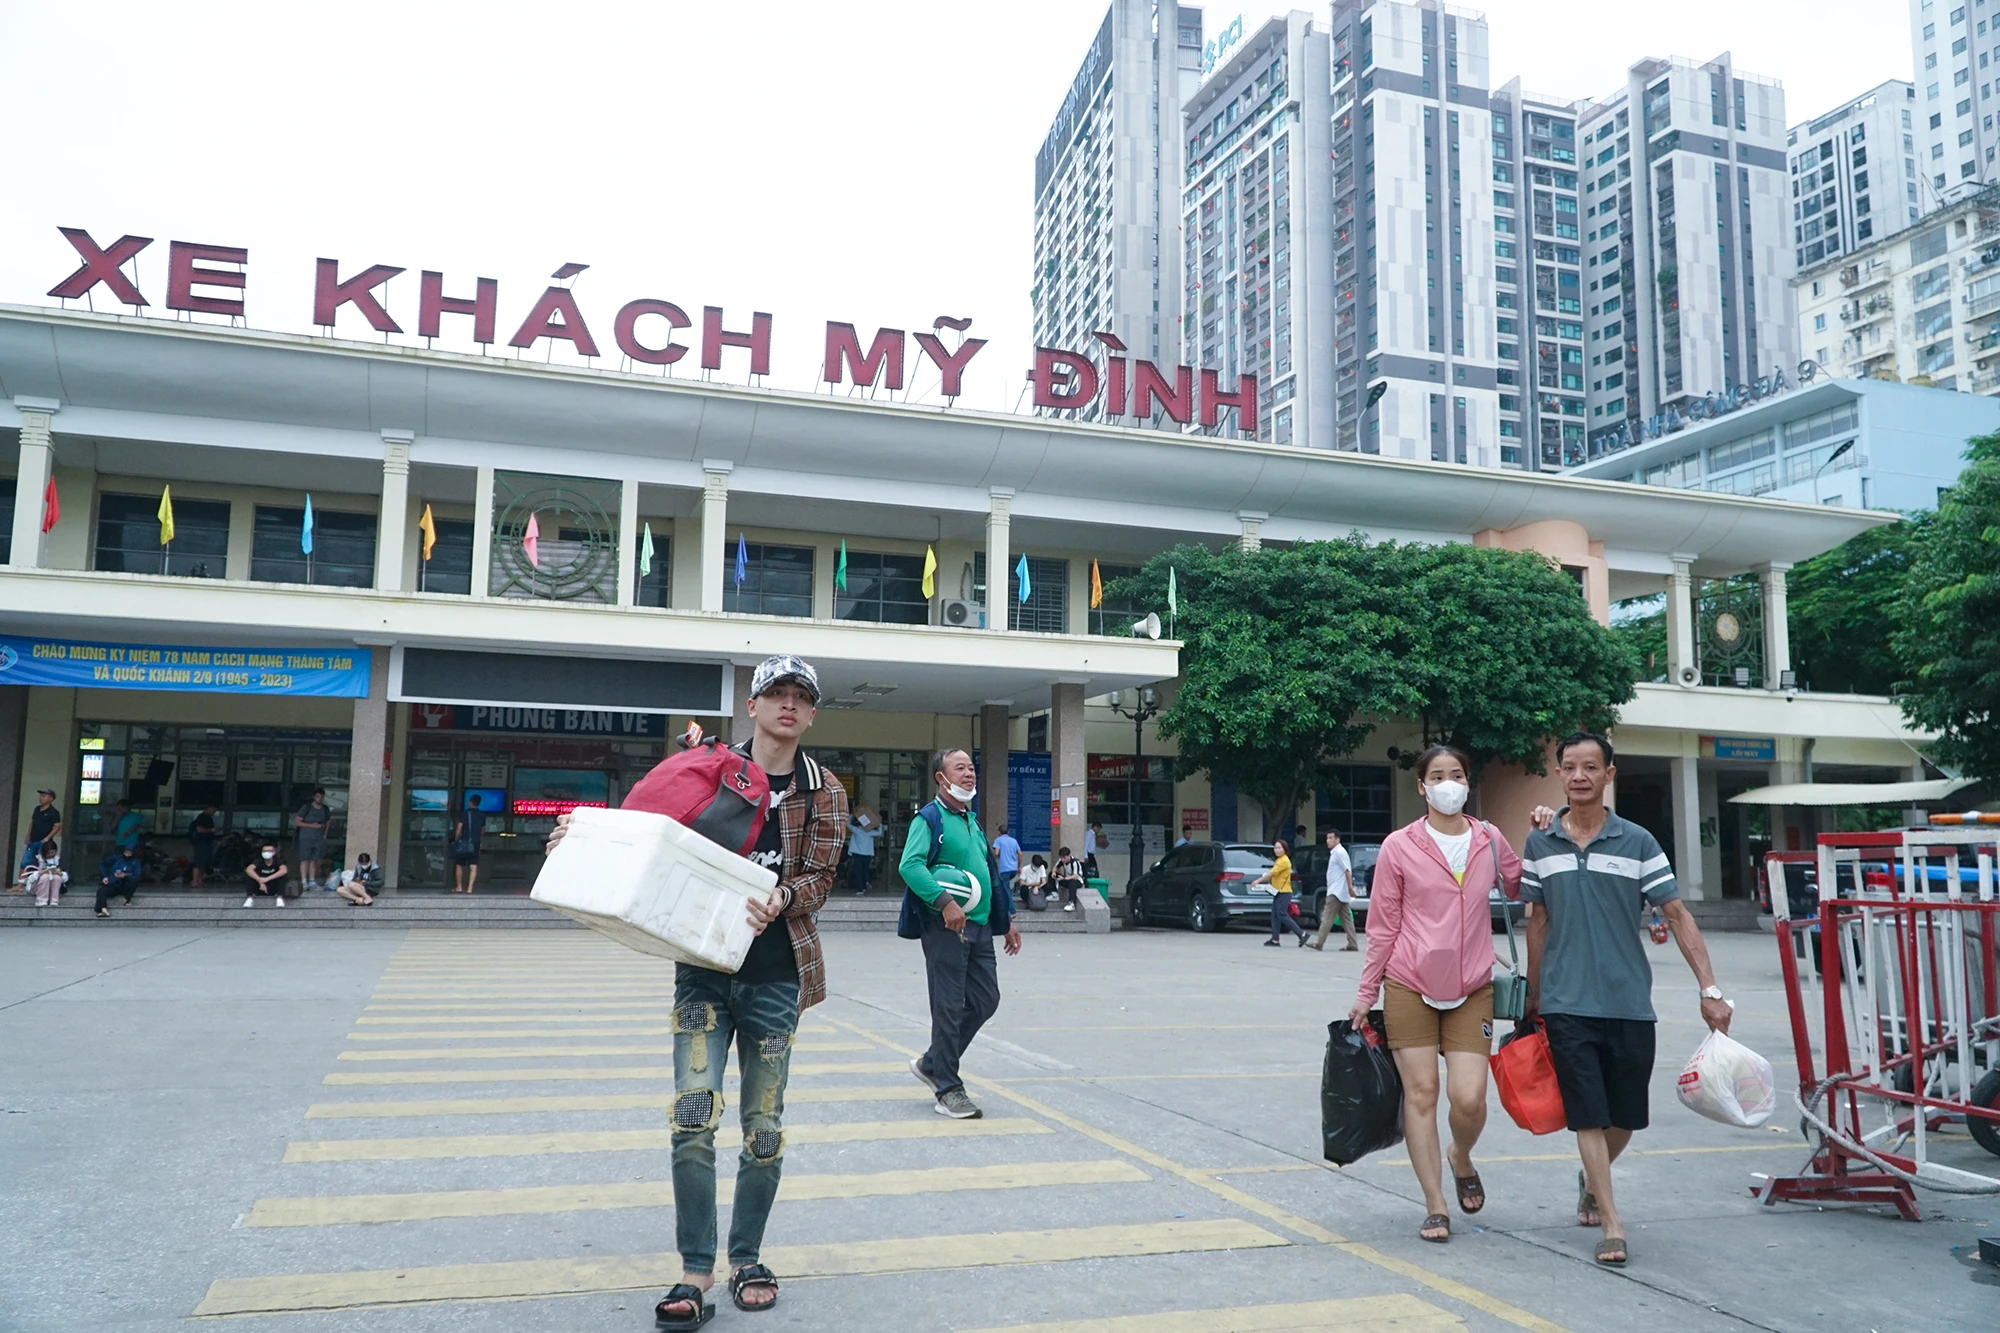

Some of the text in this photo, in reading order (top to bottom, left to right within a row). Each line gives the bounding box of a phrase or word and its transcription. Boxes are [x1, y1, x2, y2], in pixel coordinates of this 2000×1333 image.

[47, 226, 1258, 432] XE KHÁCH MỸ ĐÌNH
[32, 643, 66, 659] CHÀO
[129, 647, 161, 666] NIỆM
[164, 651, 178, 664] 78
[248, 655, 283, 669] MẠNG
[287, 654, 324, 670] THÁNG
[327, 655, 353, 670] TÁM
[94, 664, 109, 681] VÀ
[112, 664, 145, 682] QUỐC
[148, 666, 190, 683] KHÁNH
[192, 672, 212, 684] 2/9
[215, 671, 249, 686] (1945
[259, 674, 293, 688] 2023)
